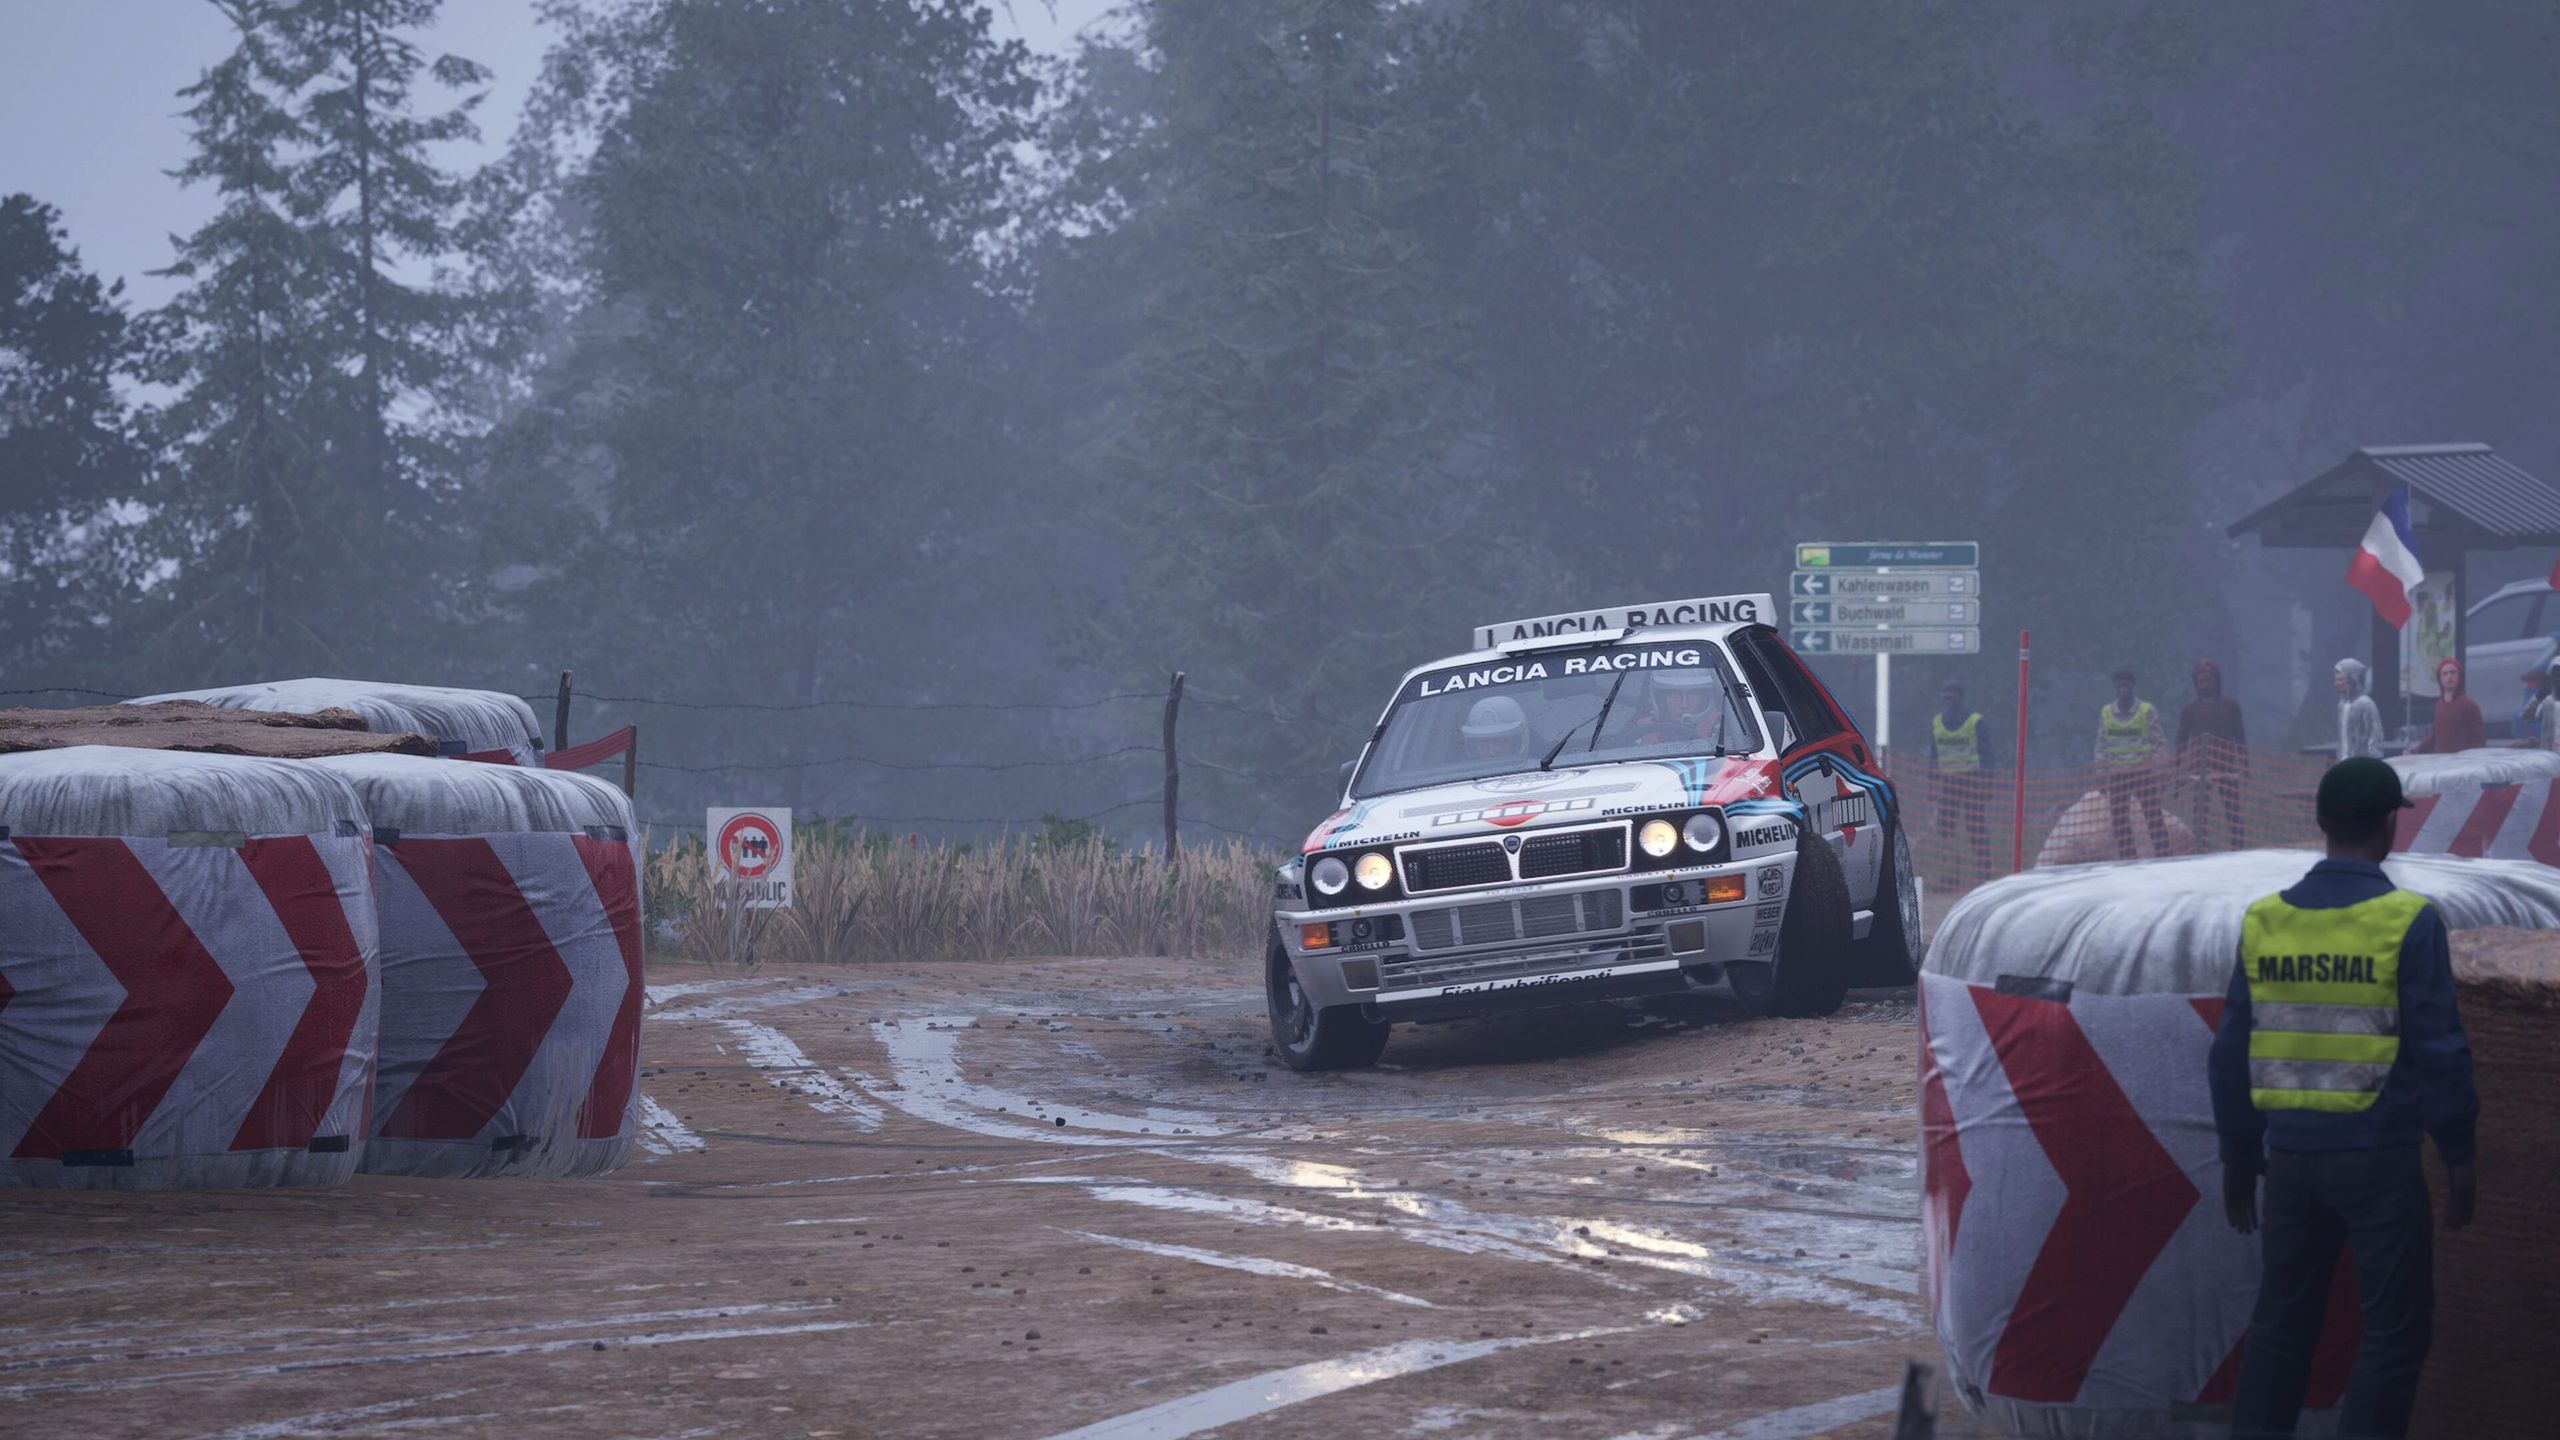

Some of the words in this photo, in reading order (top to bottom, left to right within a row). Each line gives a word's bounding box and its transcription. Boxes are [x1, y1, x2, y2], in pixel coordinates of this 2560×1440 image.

[1837, 578, 1929, 593] Kahlenwasen
[1627, 600, 1757, 630] RACING
[1838, 605, 1905, 621] Buchwald
[1836, 633, 1914, 650] Wassmatt
[1420, 662, 1548, 697] LANCIA
[1564, 650, 1701, 675] RACING
[1602, 802, 1686, 816] MICHELIN
[1339, 830, 1421, 848] MICHELIN
[1735, 822, 1797, 849] MICHELIN
[2257, 953, 2378, 984] MARSHAL
